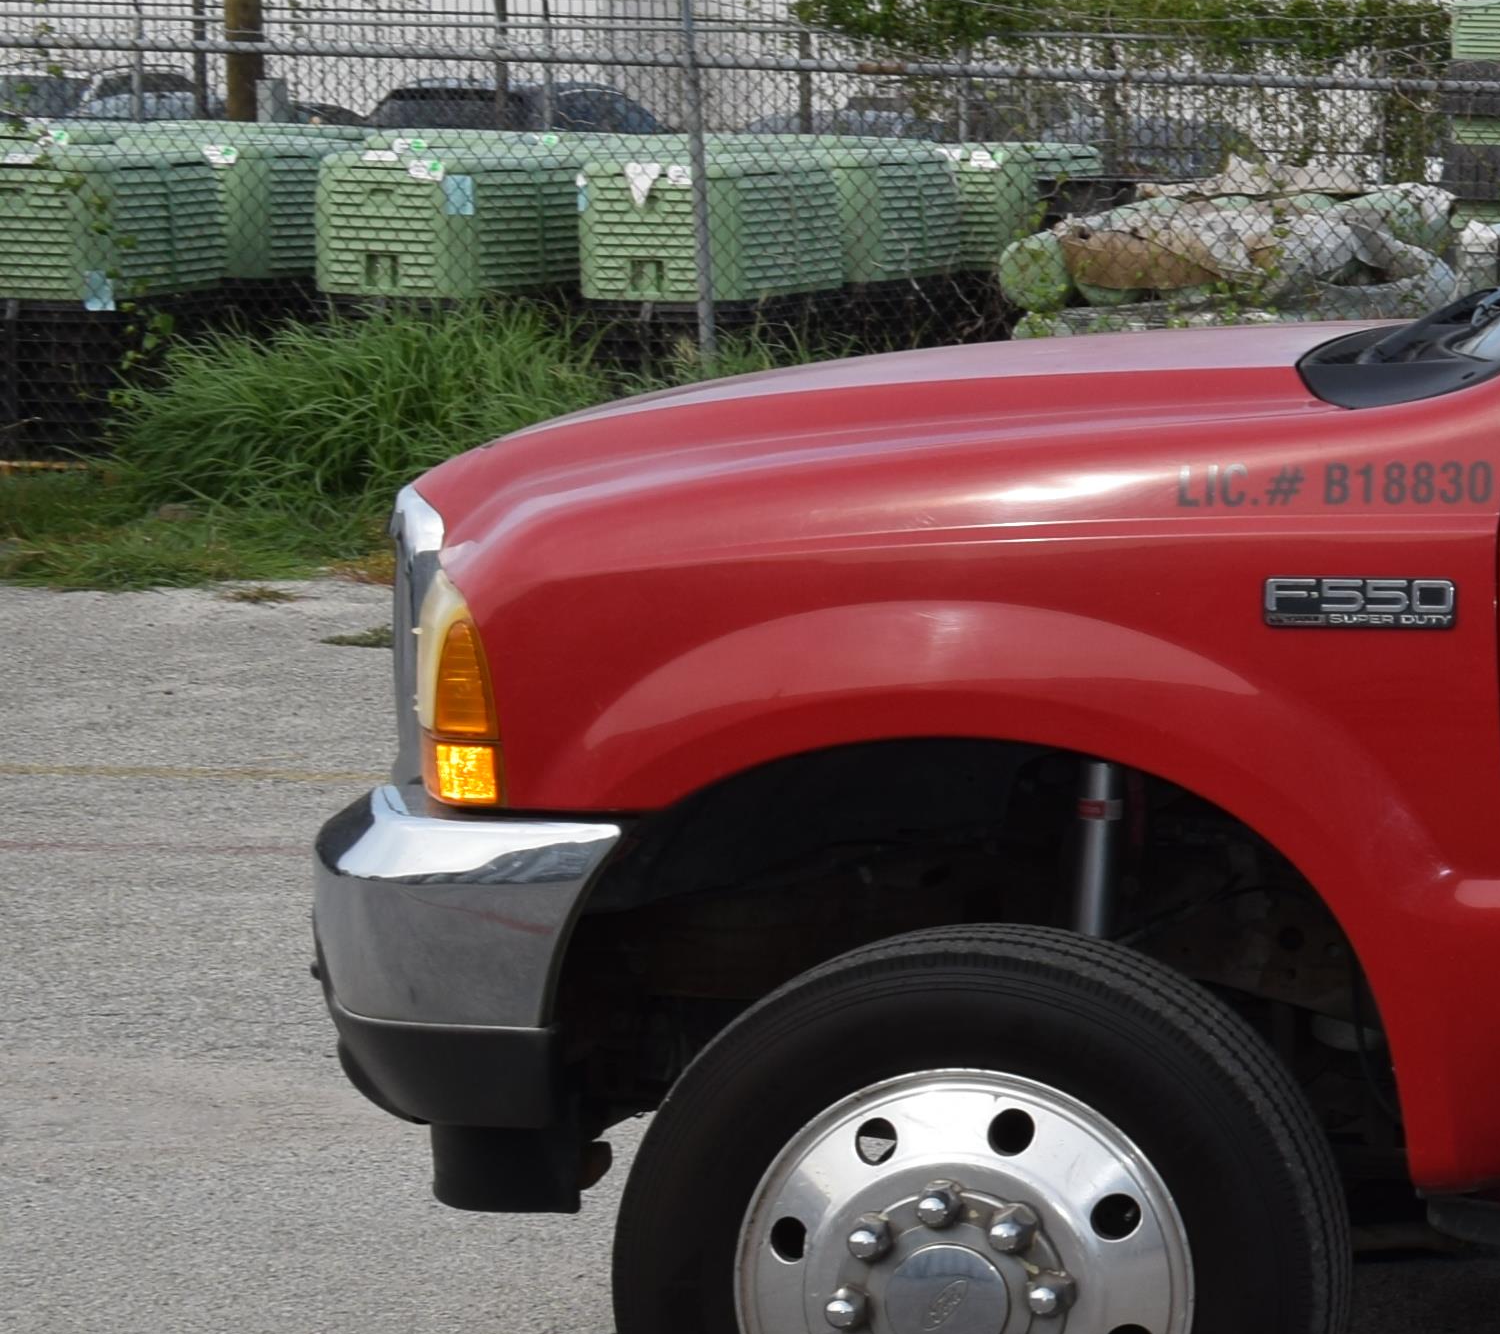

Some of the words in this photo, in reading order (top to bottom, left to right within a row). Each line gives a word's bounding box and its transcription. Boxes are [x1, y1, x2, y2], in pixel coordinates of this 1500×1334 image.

[1324, 461, 1493, 505] B18830
[1329, 613, 1394, 625] SUPER
[1401, 614, 1453, 625] DUTY
